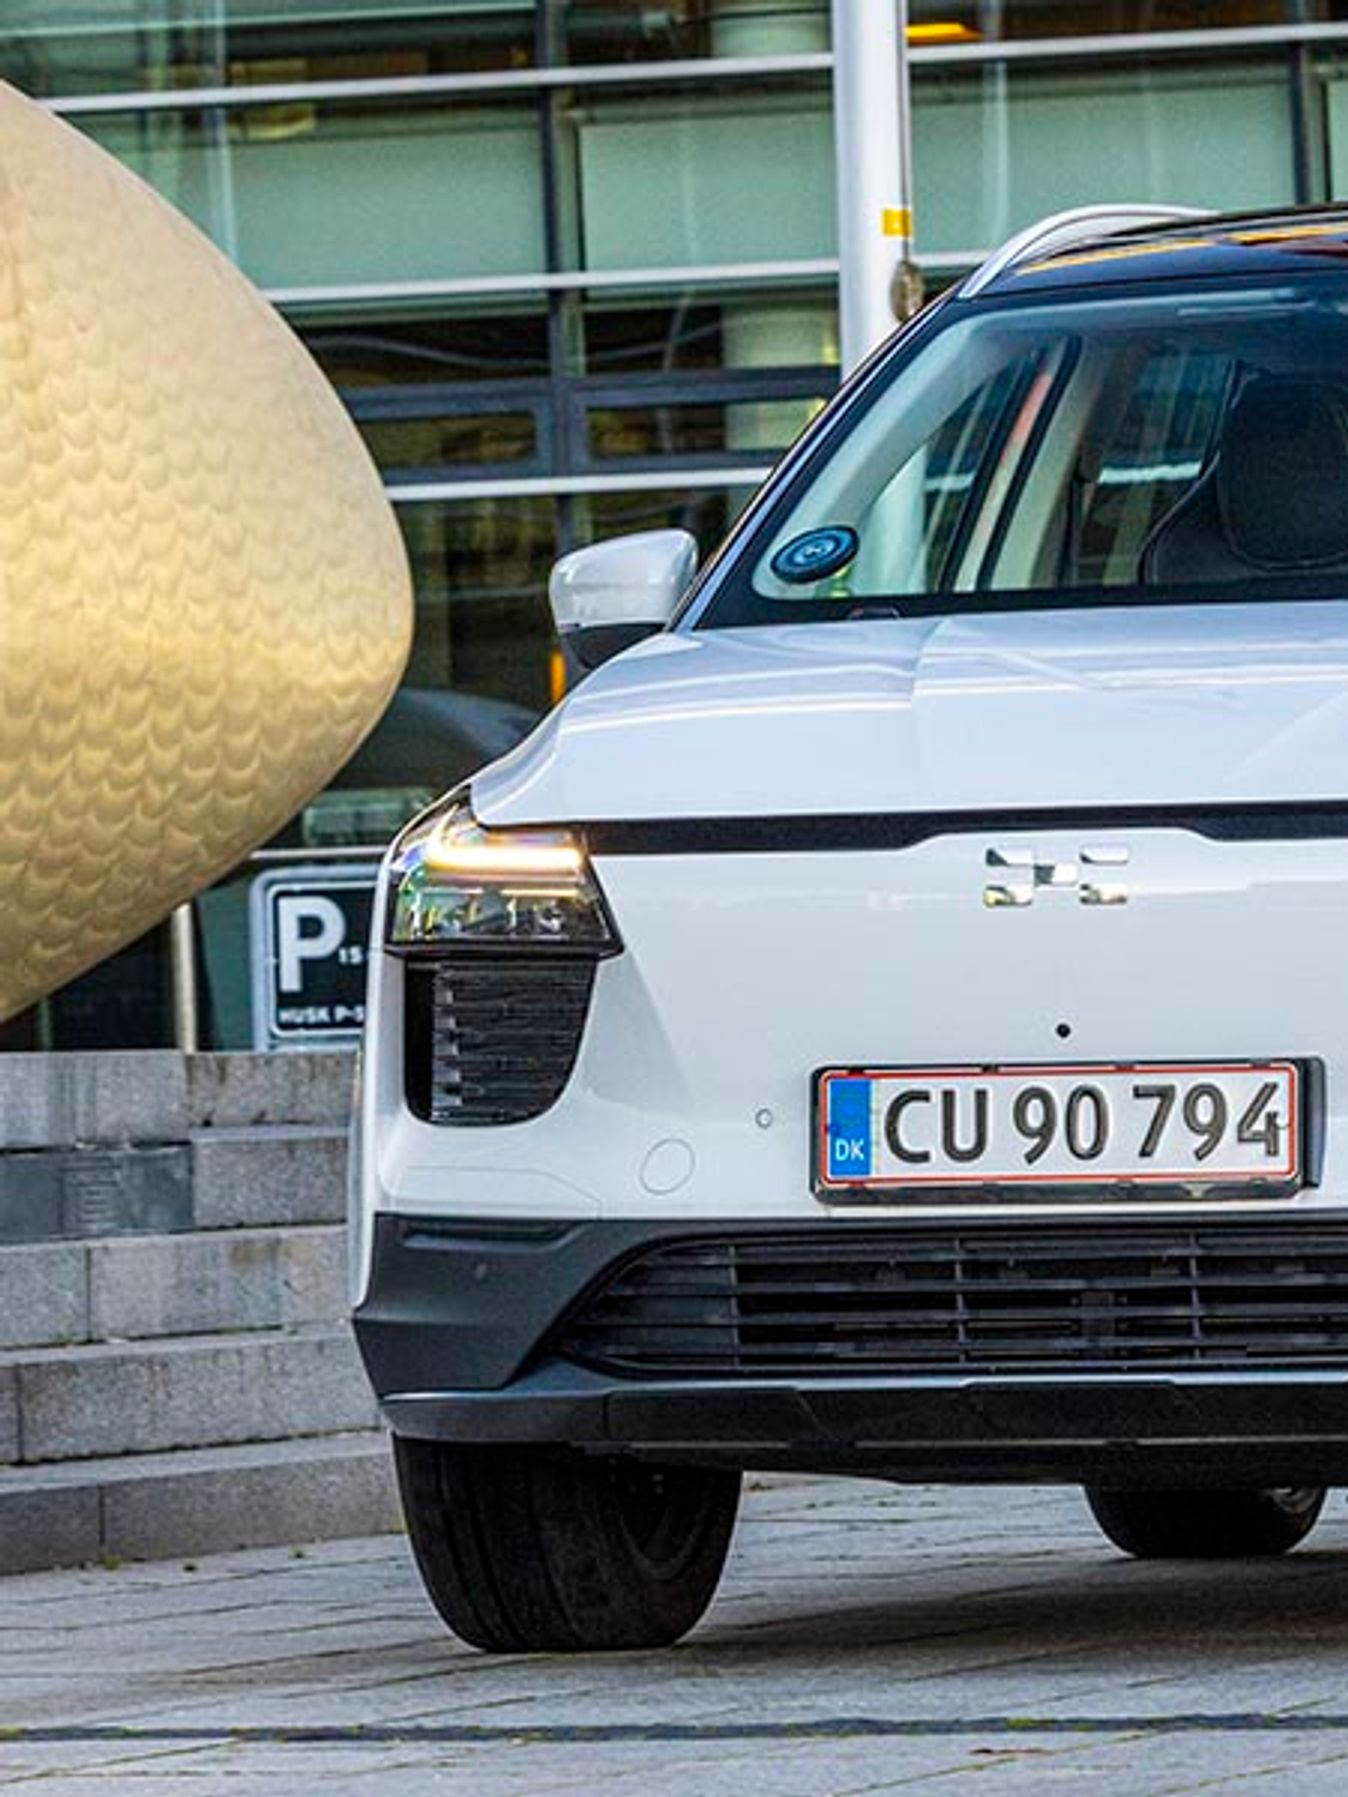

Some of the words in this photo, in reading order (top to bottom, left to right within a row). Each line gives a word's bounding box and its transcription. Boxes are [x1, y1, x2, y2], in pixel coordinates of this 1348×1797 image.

[278, 896, 345, 992] P
[835, 1140, 865, 1161] DK
[884, 1089, 988, 1163] CU
[1012, 1086, 1110, 1165] 90
[1132, 1082, 1281, 1161] 794
